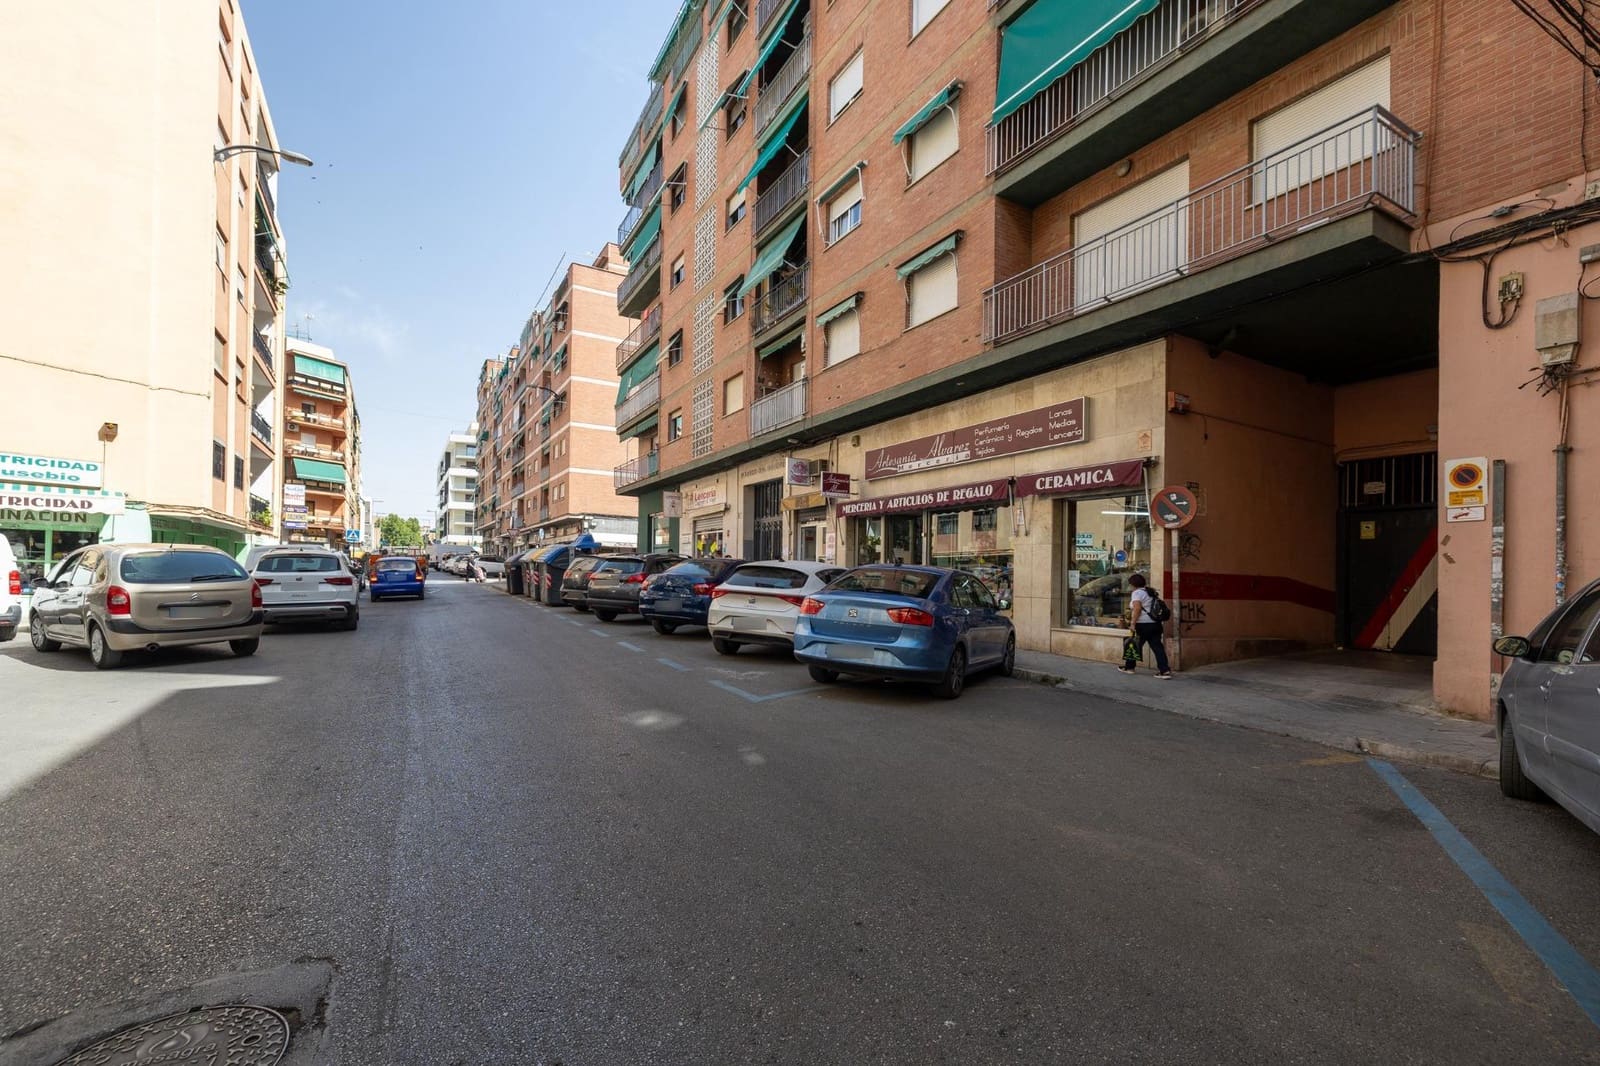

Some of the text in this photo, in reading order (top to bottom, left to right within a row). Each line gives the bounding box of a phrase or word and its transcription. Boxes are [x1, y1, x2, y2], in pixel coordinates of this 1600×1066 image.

[1049, 409, 1073, 419] Lanas
[974, 422, 1010, 436] Perfumería
[1049, 419, 1076, 430] Medias
[1007, 434, 1013, 442] y
[1016, 426, 1043, 438] Regalos
[1049, 427, 1082, 441] Lencería
[868, 434, 970, 471] Artesanía Alvarez
[974, 447, 996, 458] Tejidos
[1035, 468, 1114, 490] CERAMICA
[842, 484, 993, 514] MERCERIA Y ARTICULOS DE REGALO
